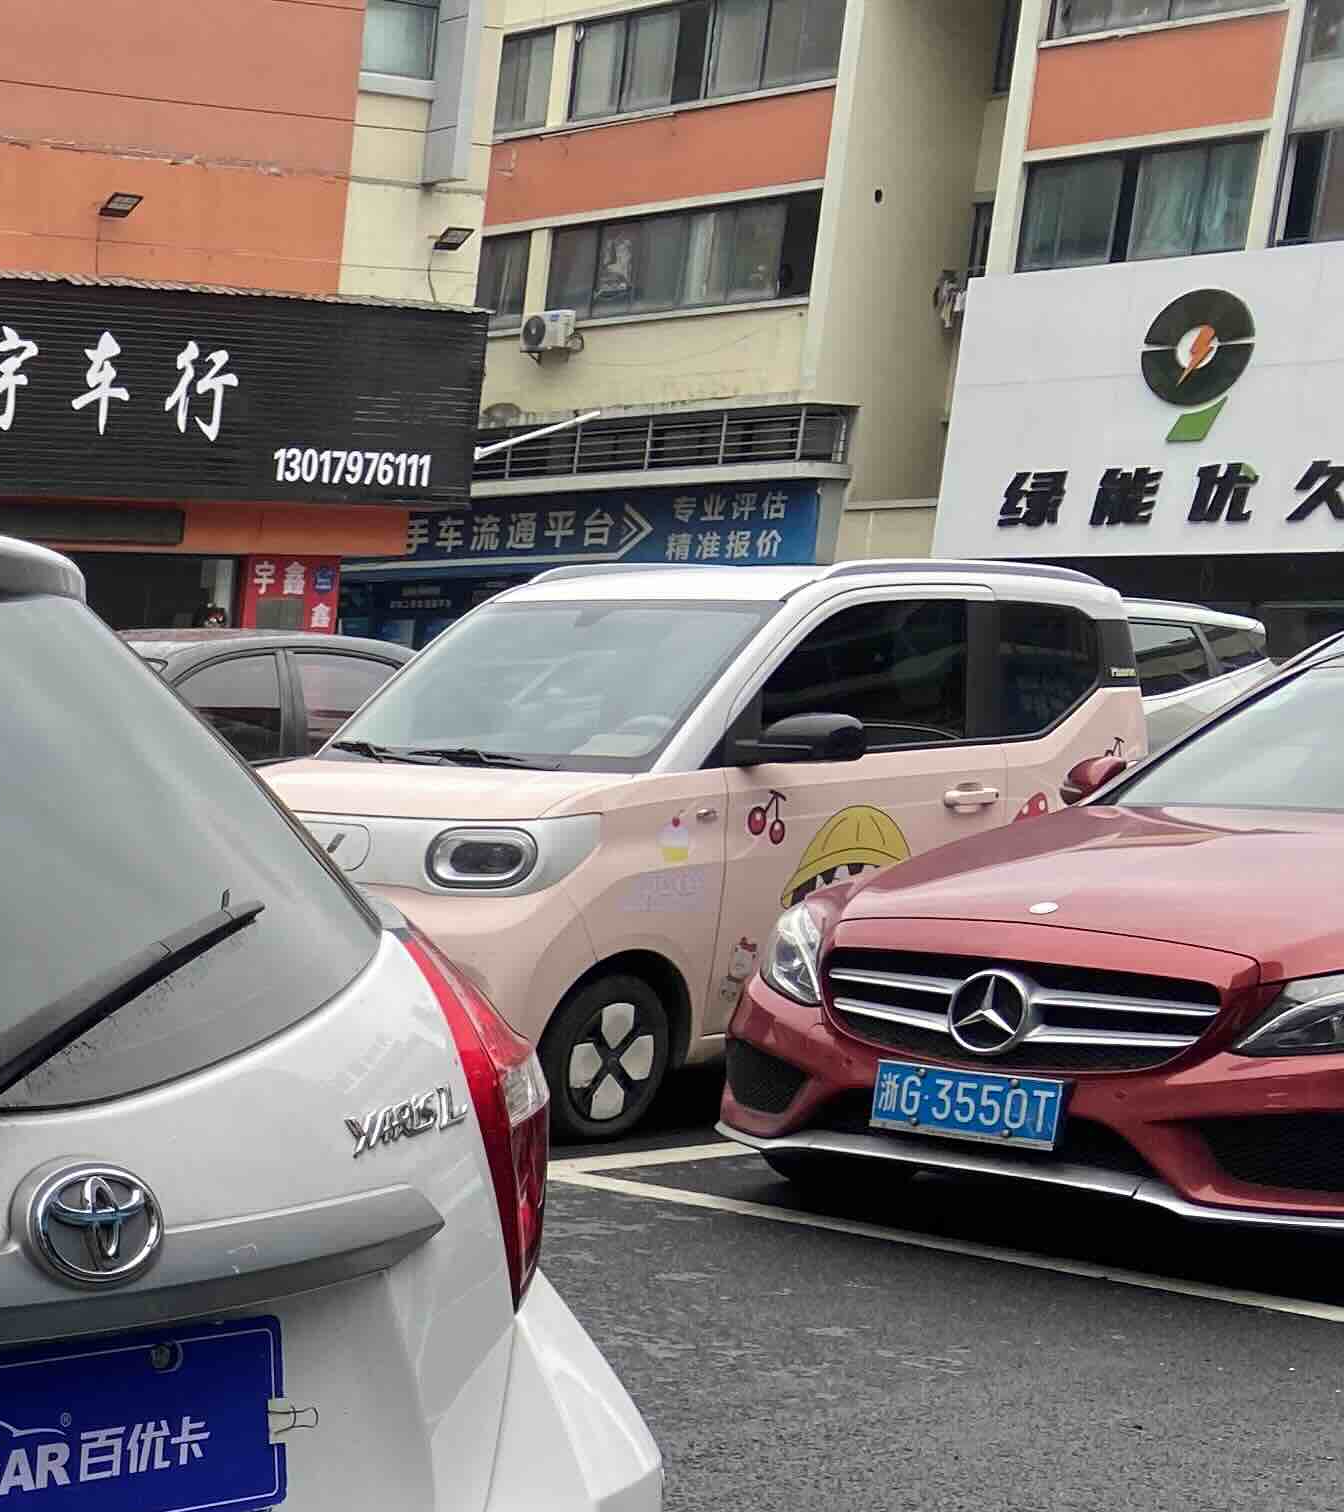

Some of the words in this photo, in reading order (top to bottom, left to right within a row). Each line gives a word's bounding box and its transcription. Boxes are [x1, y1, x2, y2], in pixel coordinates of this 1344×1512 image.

[273, 447, 432, 488] 13017976111
[671, 492, 789, 524] 专业评估
[664, 530, 784, 562] 精准报价
[79, 1415, 211, 1484] 百优卡
